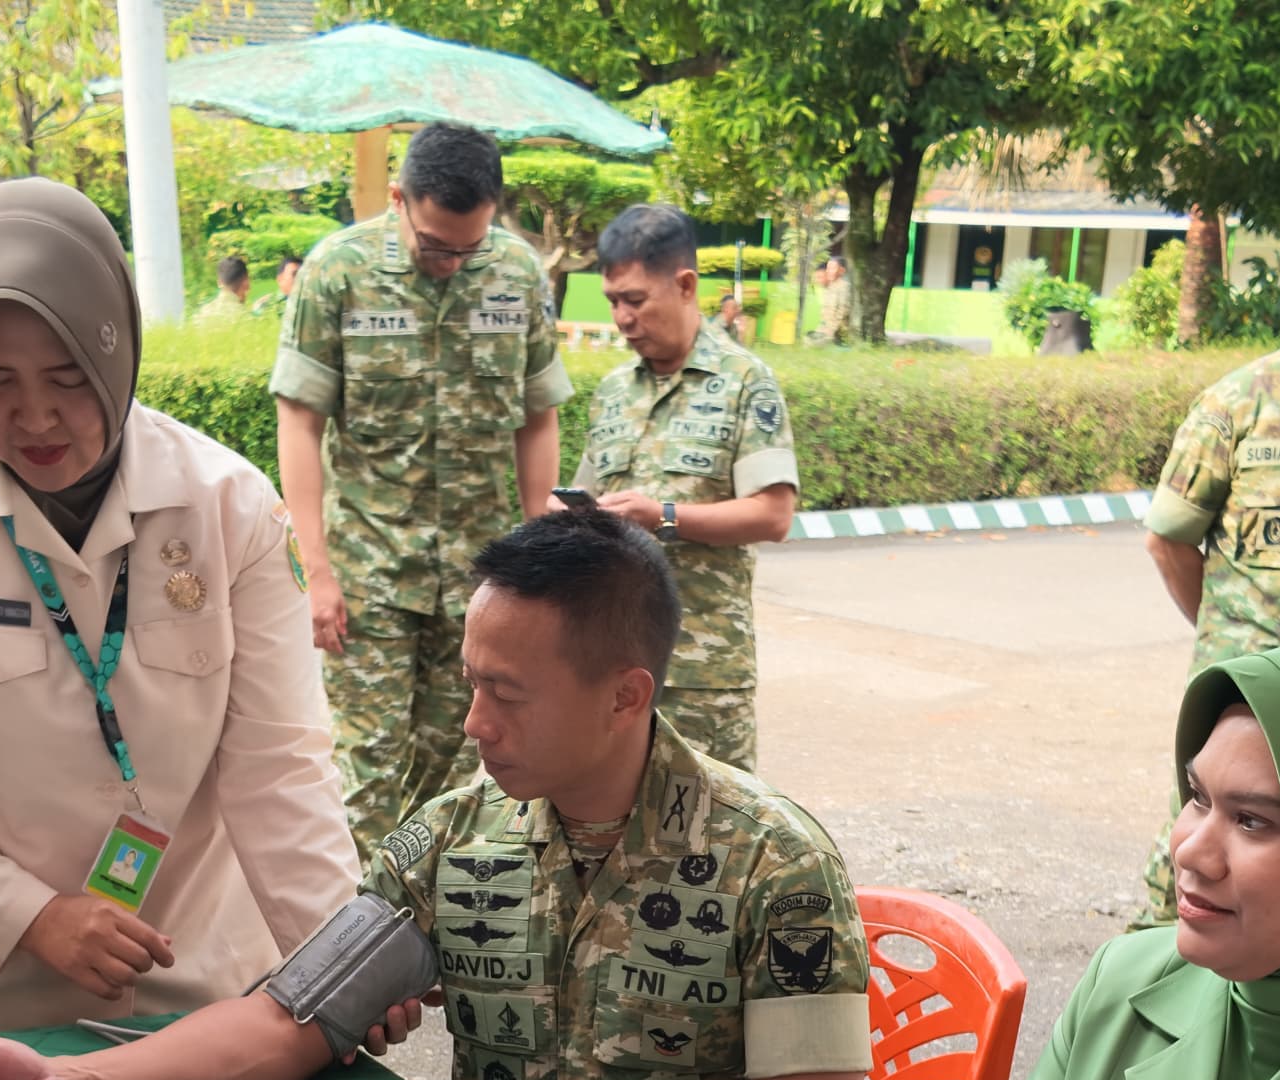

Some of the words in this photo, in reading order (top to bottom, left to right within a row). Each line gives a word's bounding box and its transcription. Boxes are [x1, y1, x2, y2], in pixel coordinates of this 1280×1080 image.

[479, 312, 527, 328] TNI-A
[621, 964, 666, 997] TNI
[681, 979, 728, 1004] AD
